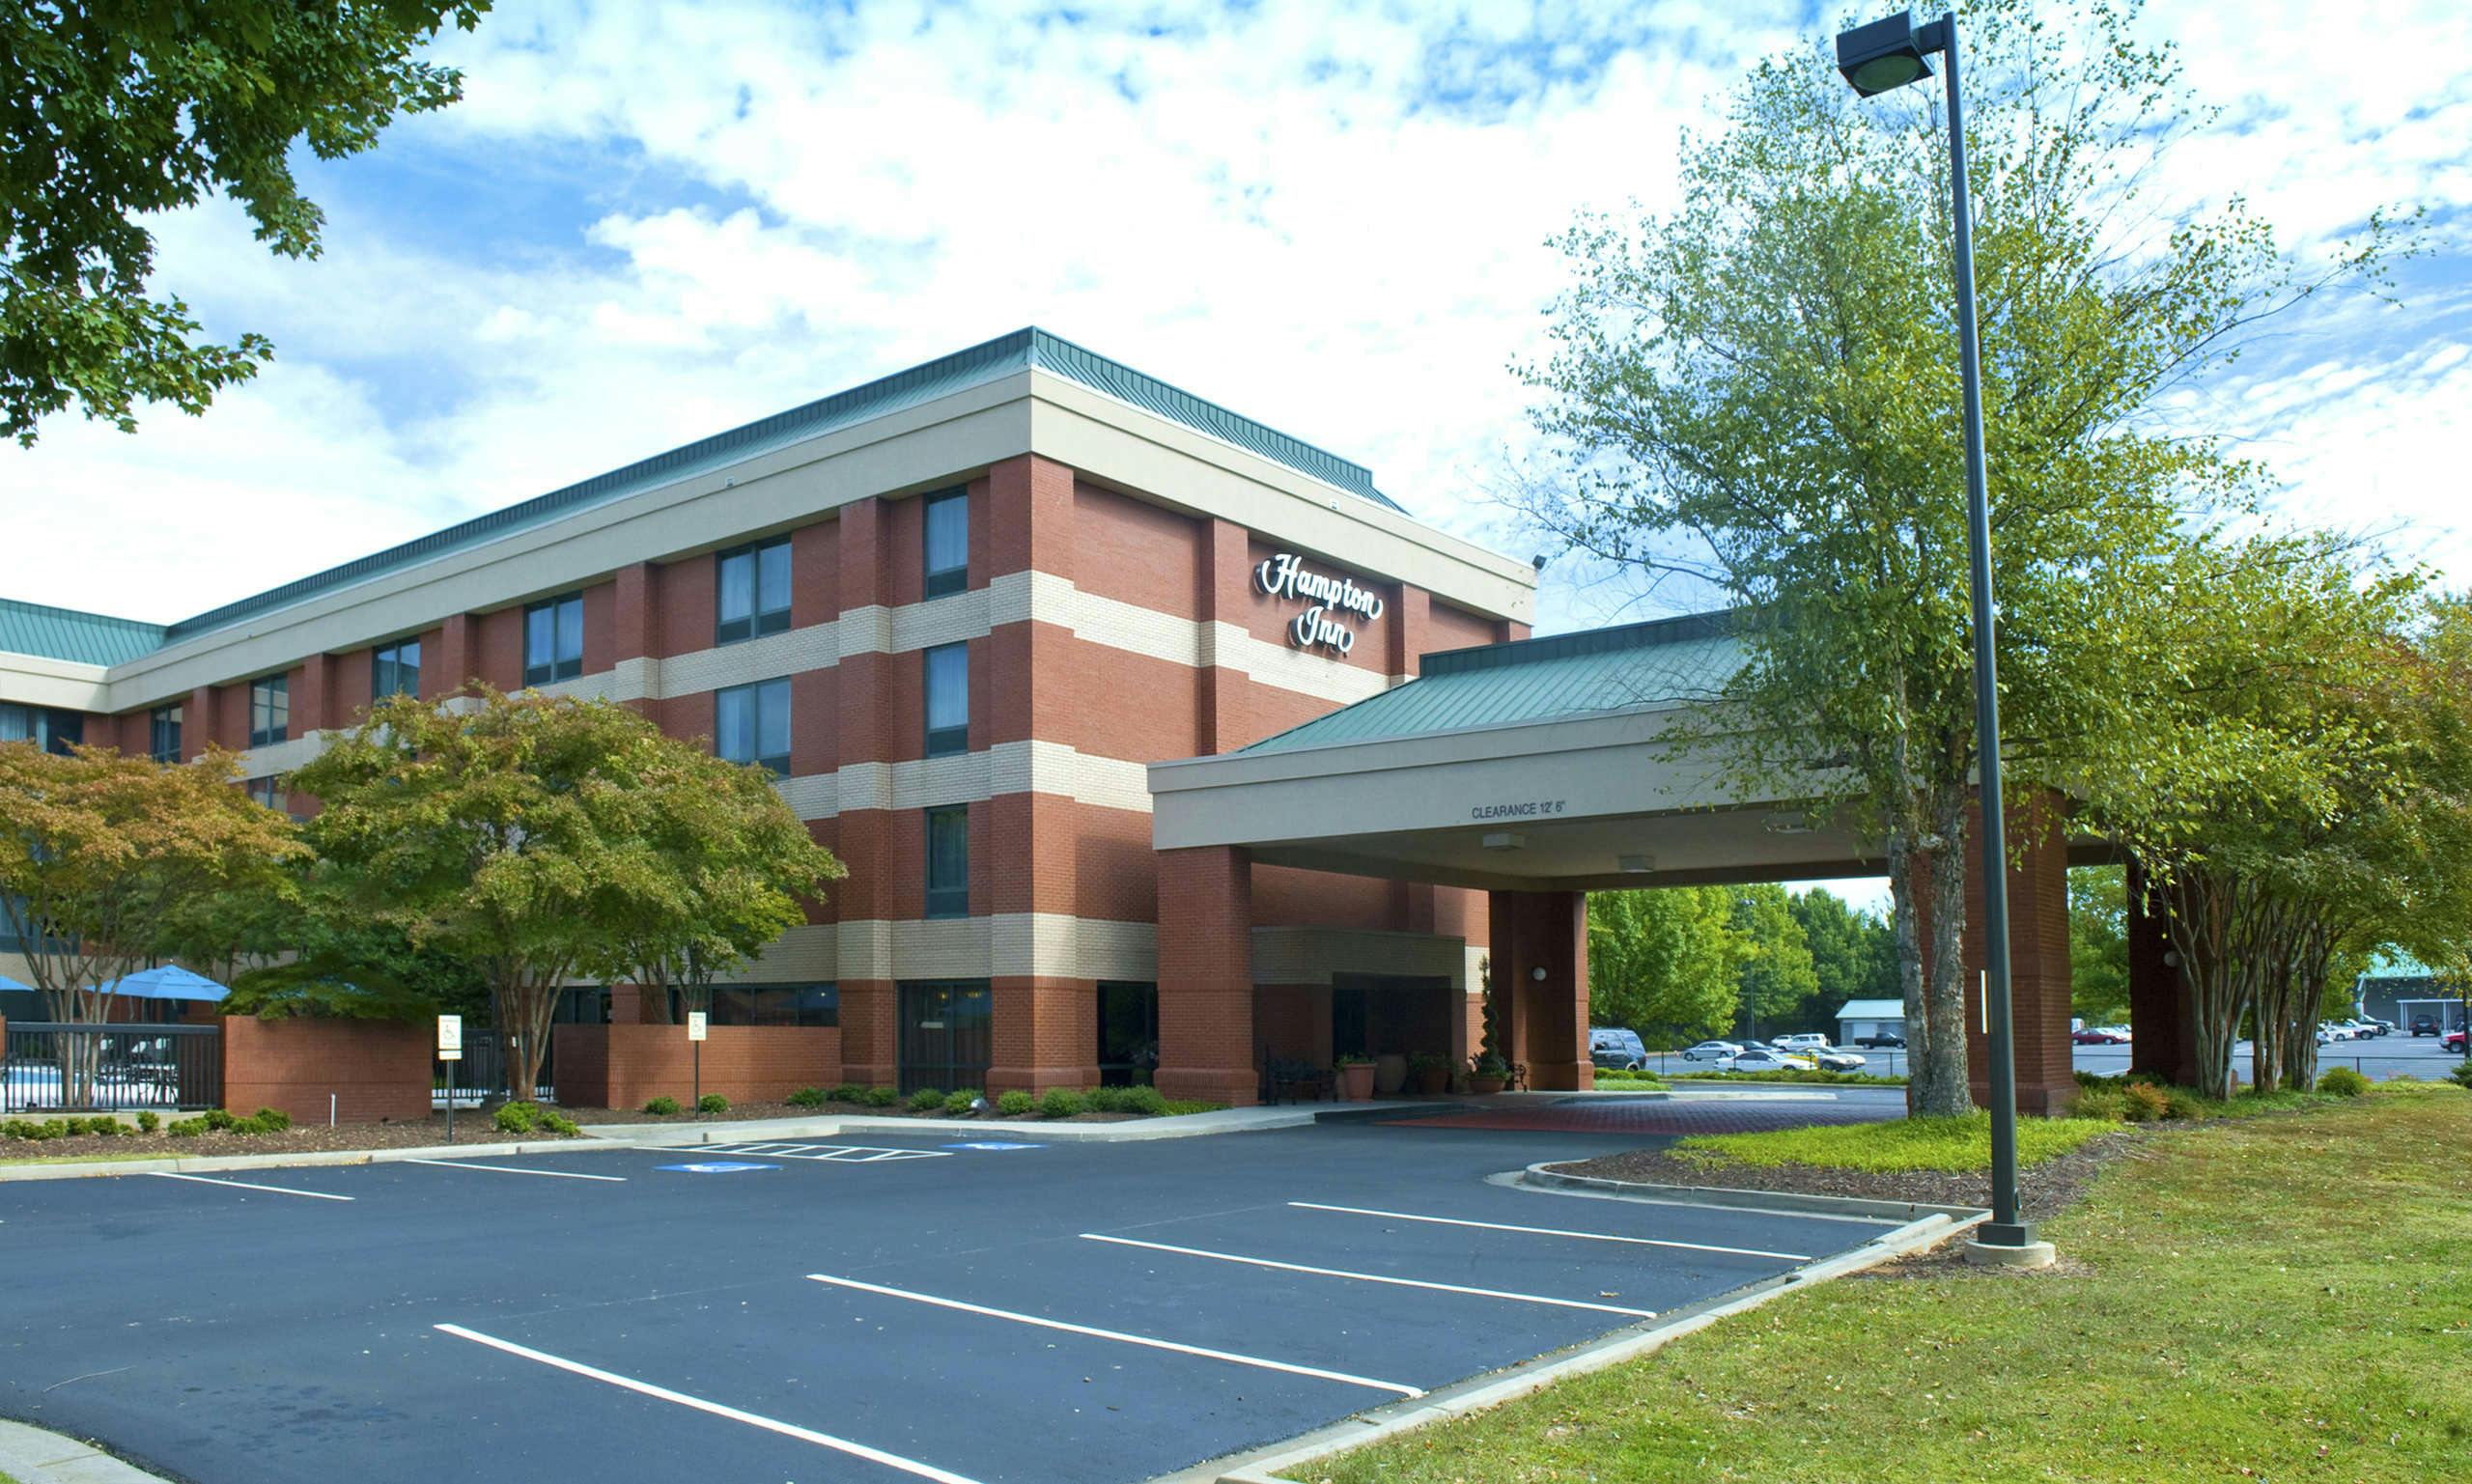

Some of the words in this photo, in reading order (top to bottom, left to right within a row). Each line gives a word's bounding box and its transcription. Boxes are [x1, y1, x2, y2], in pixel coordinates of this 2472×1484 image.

[1261, 554, 1383, 619] Hampton
[1296, 606, 1354, 652] Inn
[1472, 803, 1536, 819] CLEARANCE
